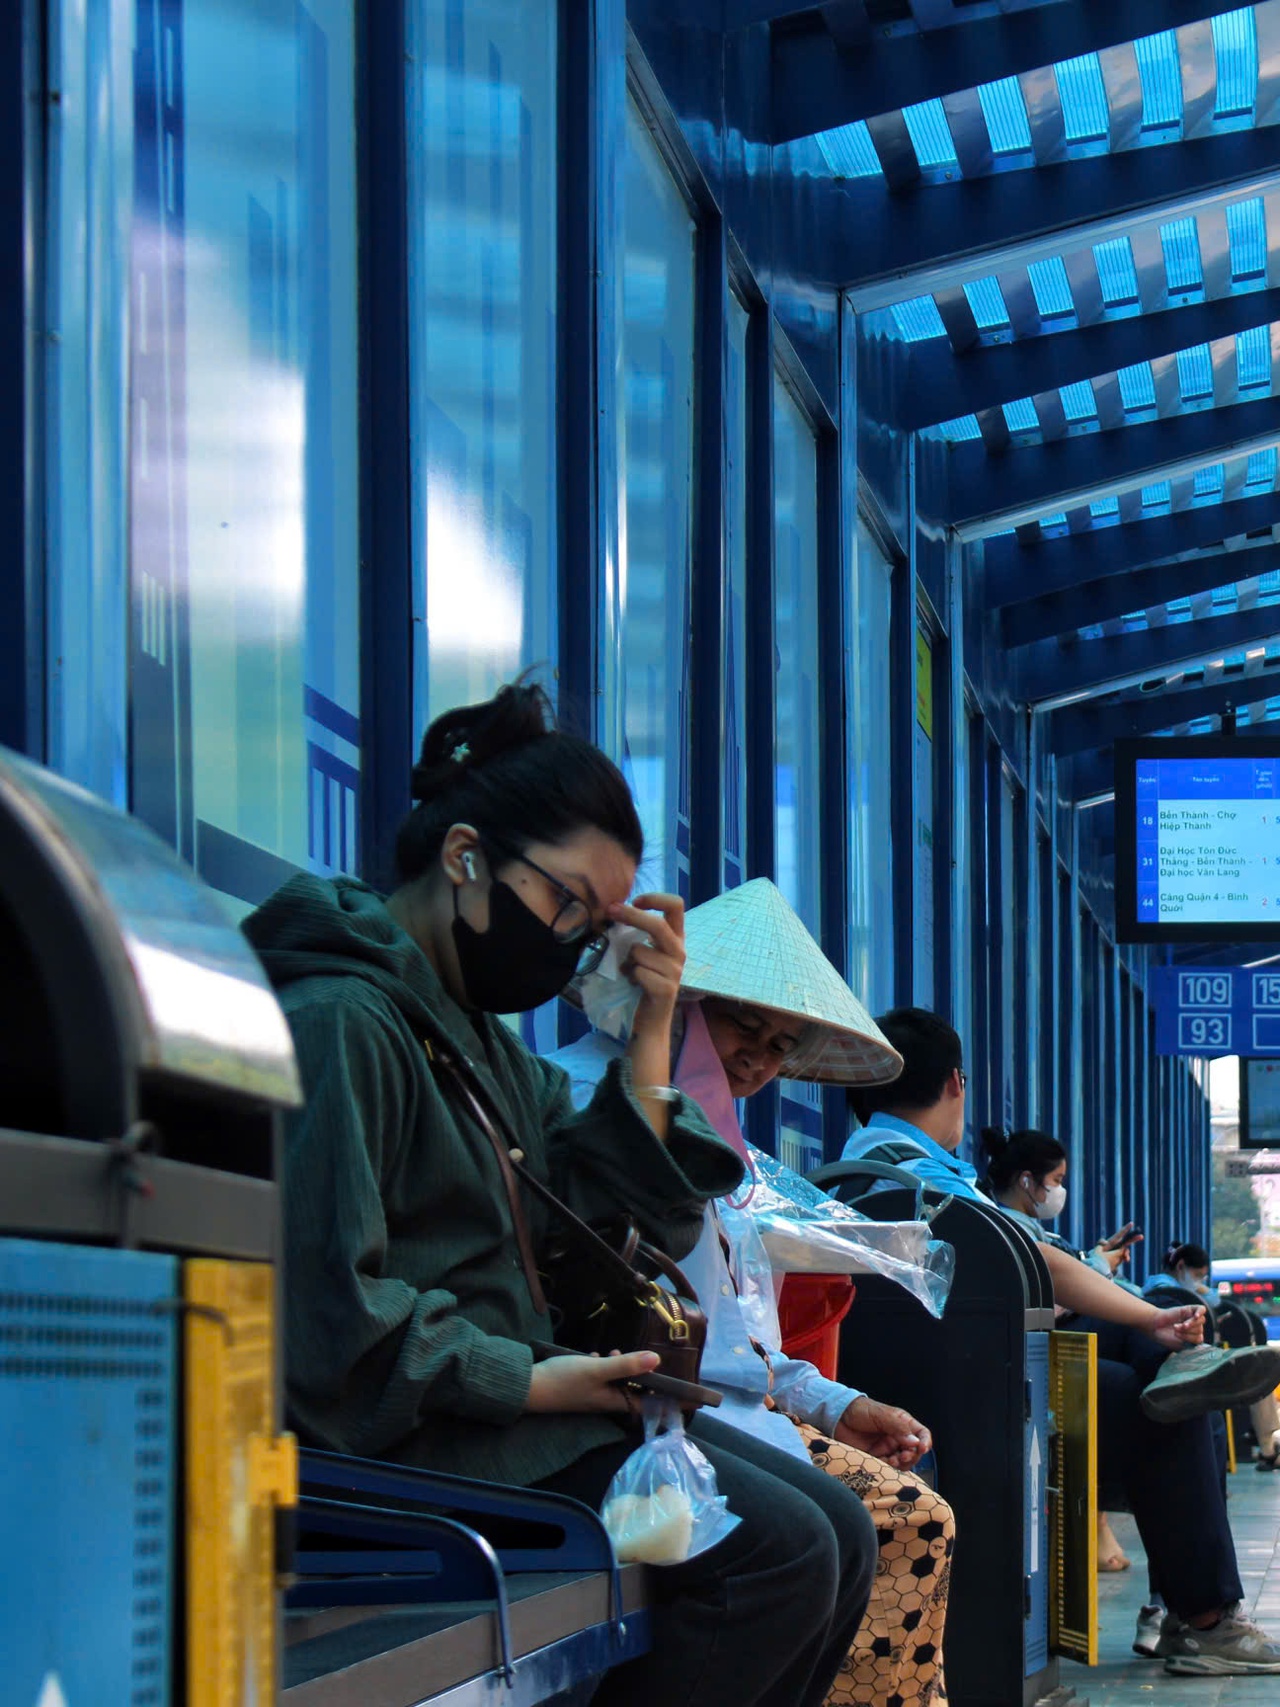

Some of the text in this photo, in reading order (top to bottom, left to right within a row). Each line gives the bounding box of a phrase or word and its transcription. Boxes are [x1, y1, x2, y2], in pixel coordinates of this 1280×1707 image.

[1261, 815, 1267, 824] 1
[1177, 846, 1195, 856] Học
[1261, 856, 1267, 865] 1
[1177, 868, 1195, 878] học
[1217, 868, 1241, 878] Lang
[1213, 893, 1220, 902] 4
[1261, 897, 1268, 906] 2
[1185, 978, 1228, 1004] 109
[1190, 1018, 1225, 1044] 93
